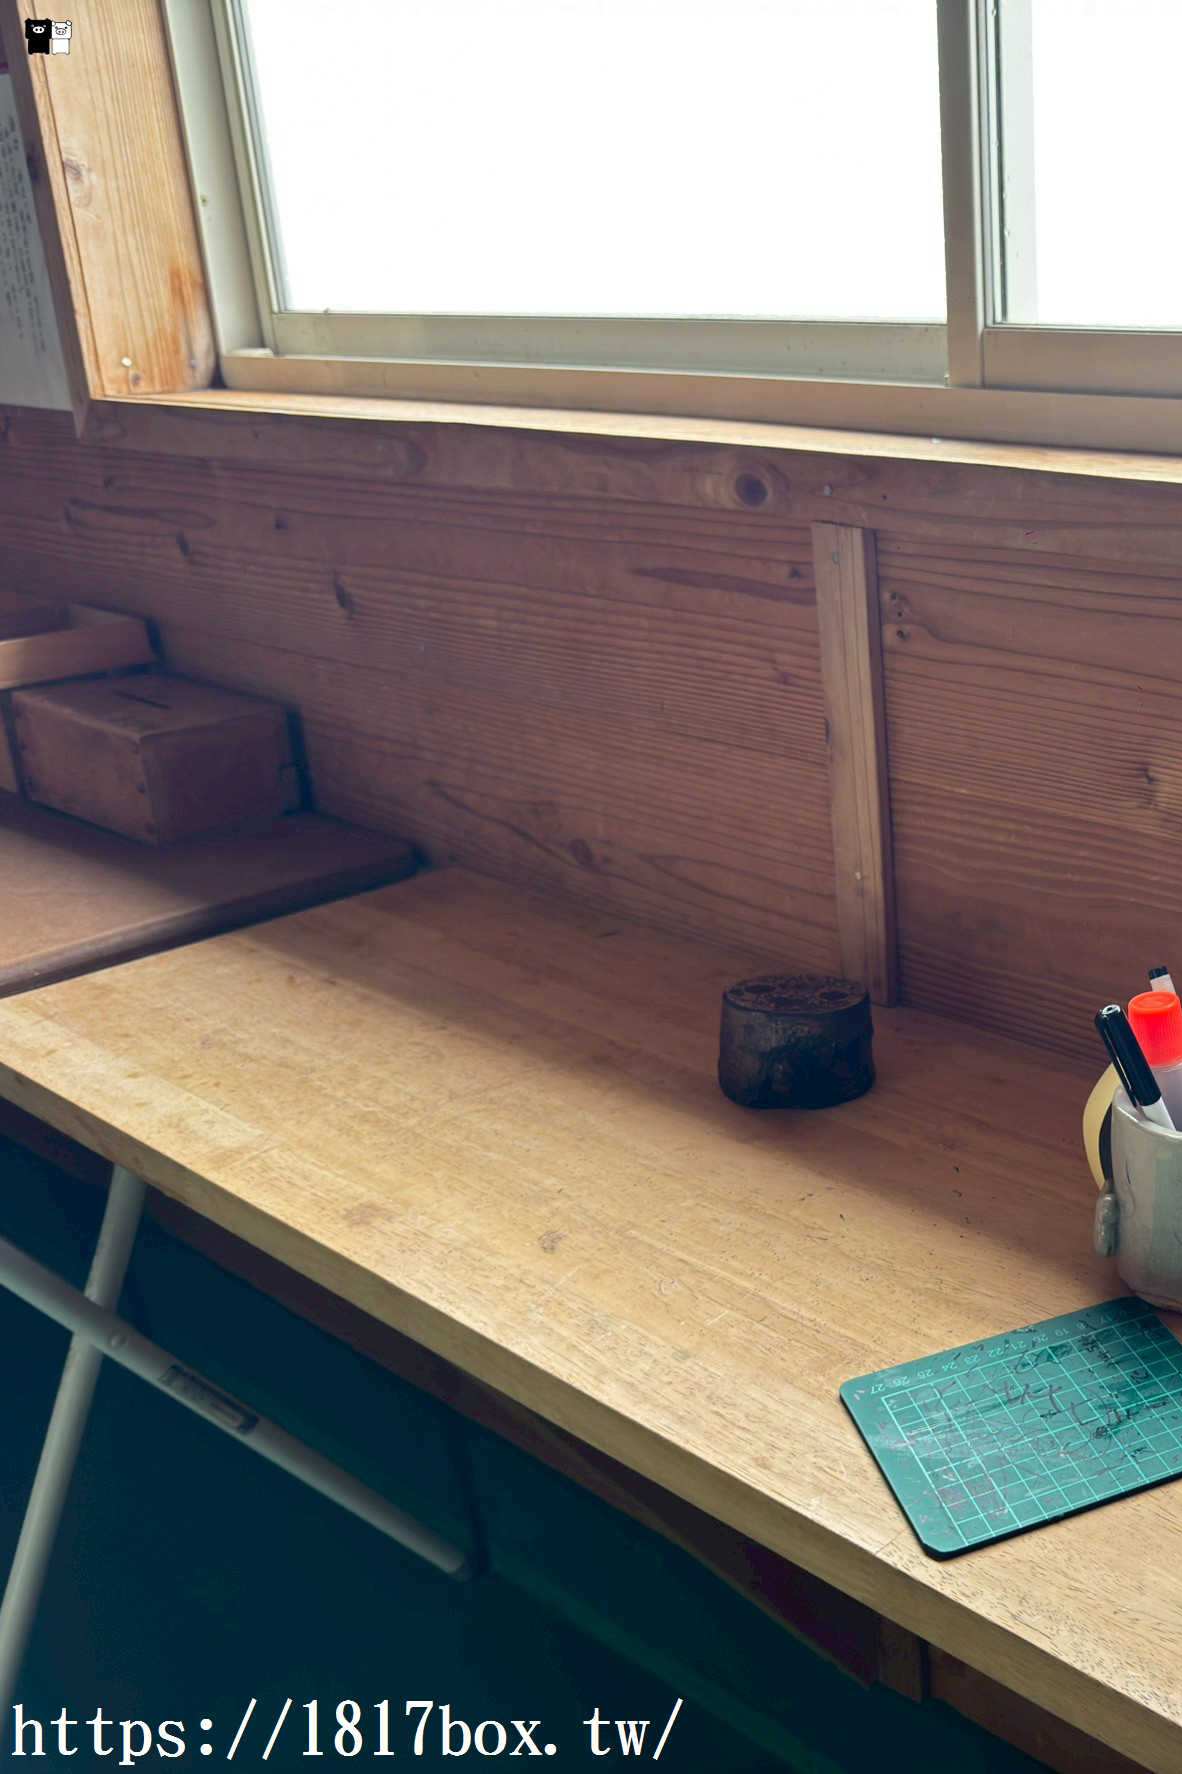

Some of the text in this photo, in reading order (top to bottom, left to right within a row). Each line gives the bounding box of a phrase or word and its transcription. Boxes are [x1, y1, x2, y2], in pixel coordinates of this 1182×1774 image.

[987, 1347, 1004, 1358] 22
[963, 1354, 981, 1365] 23
[941, 1361, 958, 1372] 24
[916, 1368, 934, 1380] 25
[870, 1383, 887, 1395] 27
